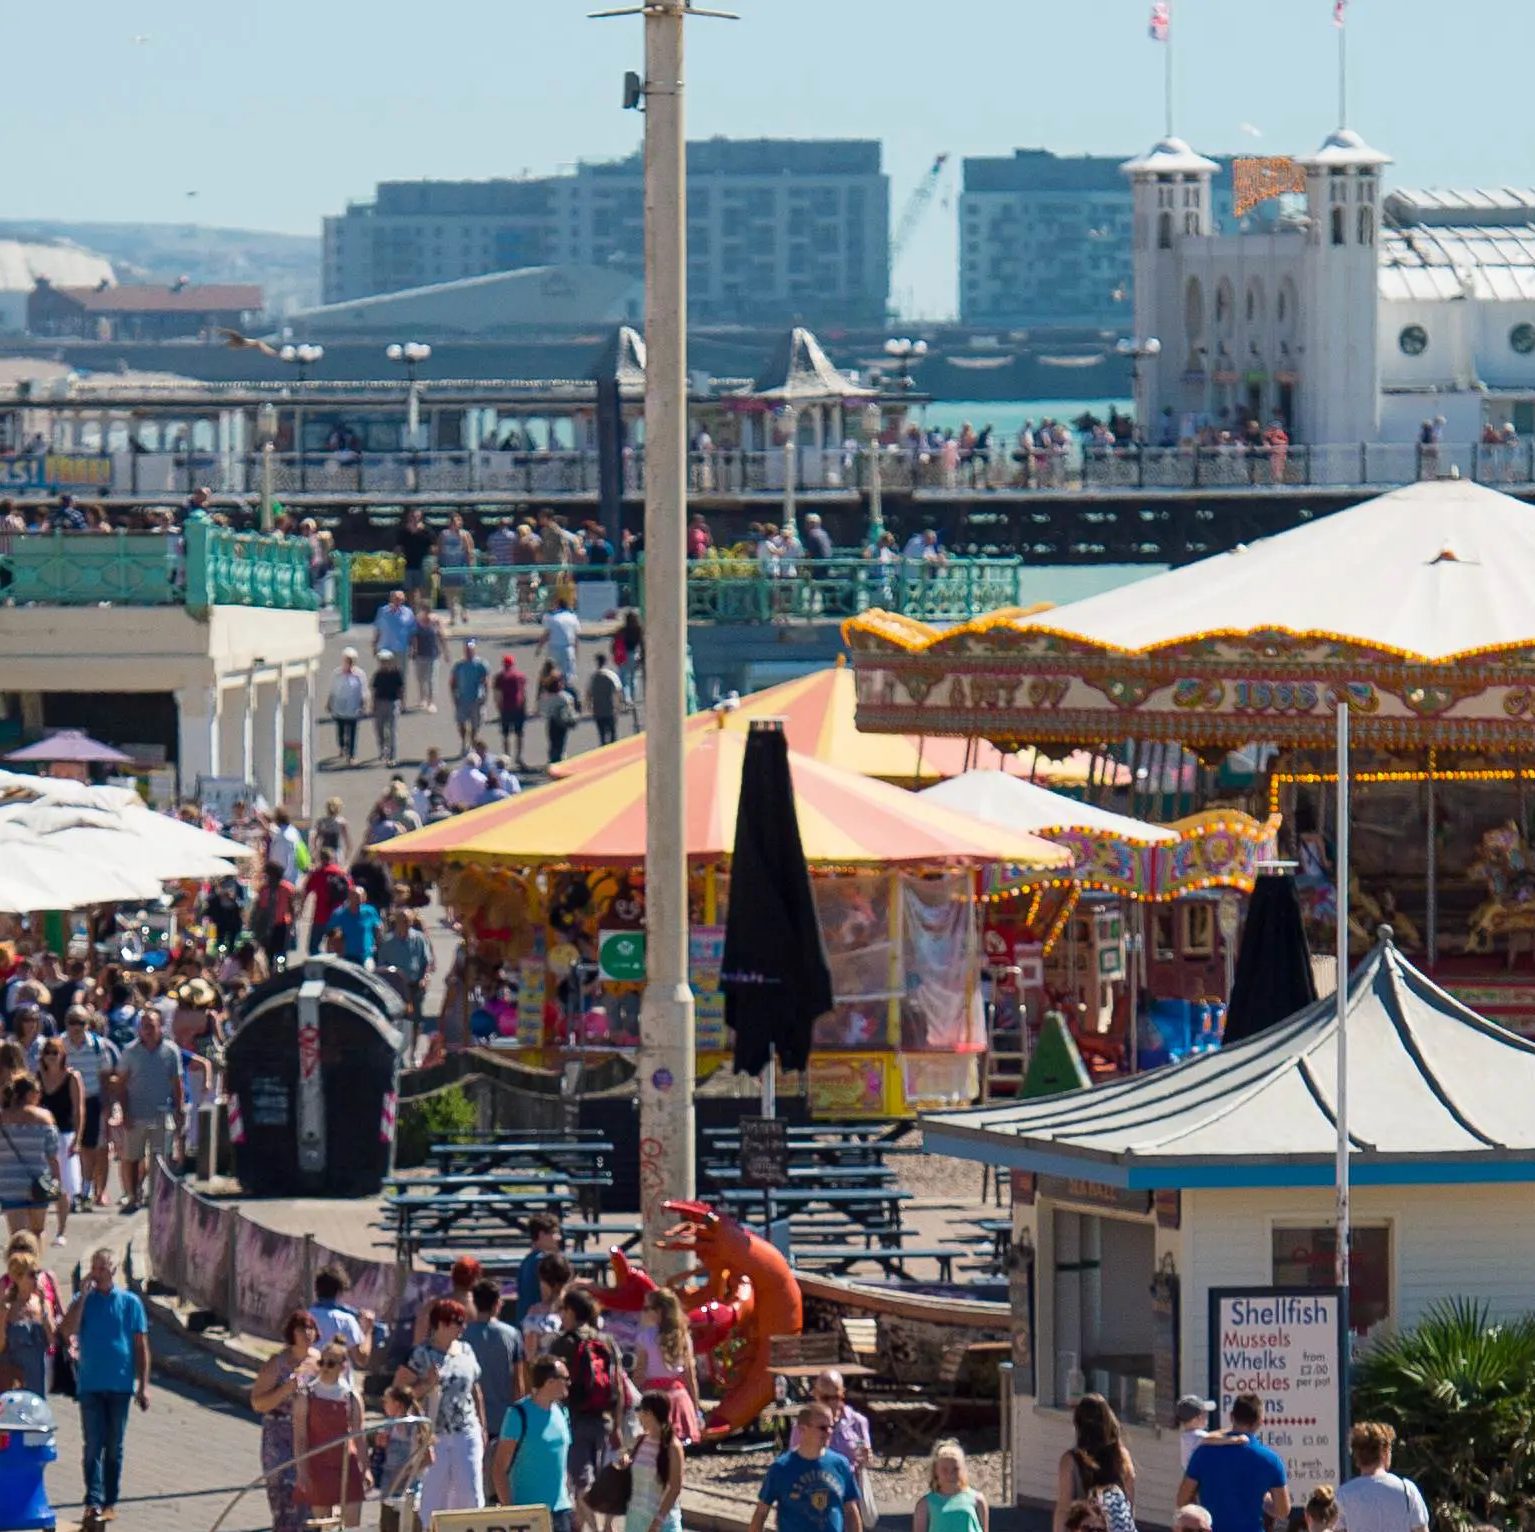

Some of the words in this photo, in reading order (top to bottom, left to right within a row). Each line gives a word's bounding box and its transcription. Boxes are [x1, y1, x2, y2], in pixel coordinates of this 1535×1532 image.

[1231, 1297, 1328, 1326] Shellfish
[1223, 1327, 1291, 1349] Mussels
[1223, 1349, 1286, 1370] Whelks
[1303, 1351, 1325, 1362] from
[1223, 1371, 1291, 1392] Cockles
[1296, 1379, 1311, 1391] per
[1268, 1432, 1293, 1446] Eels
